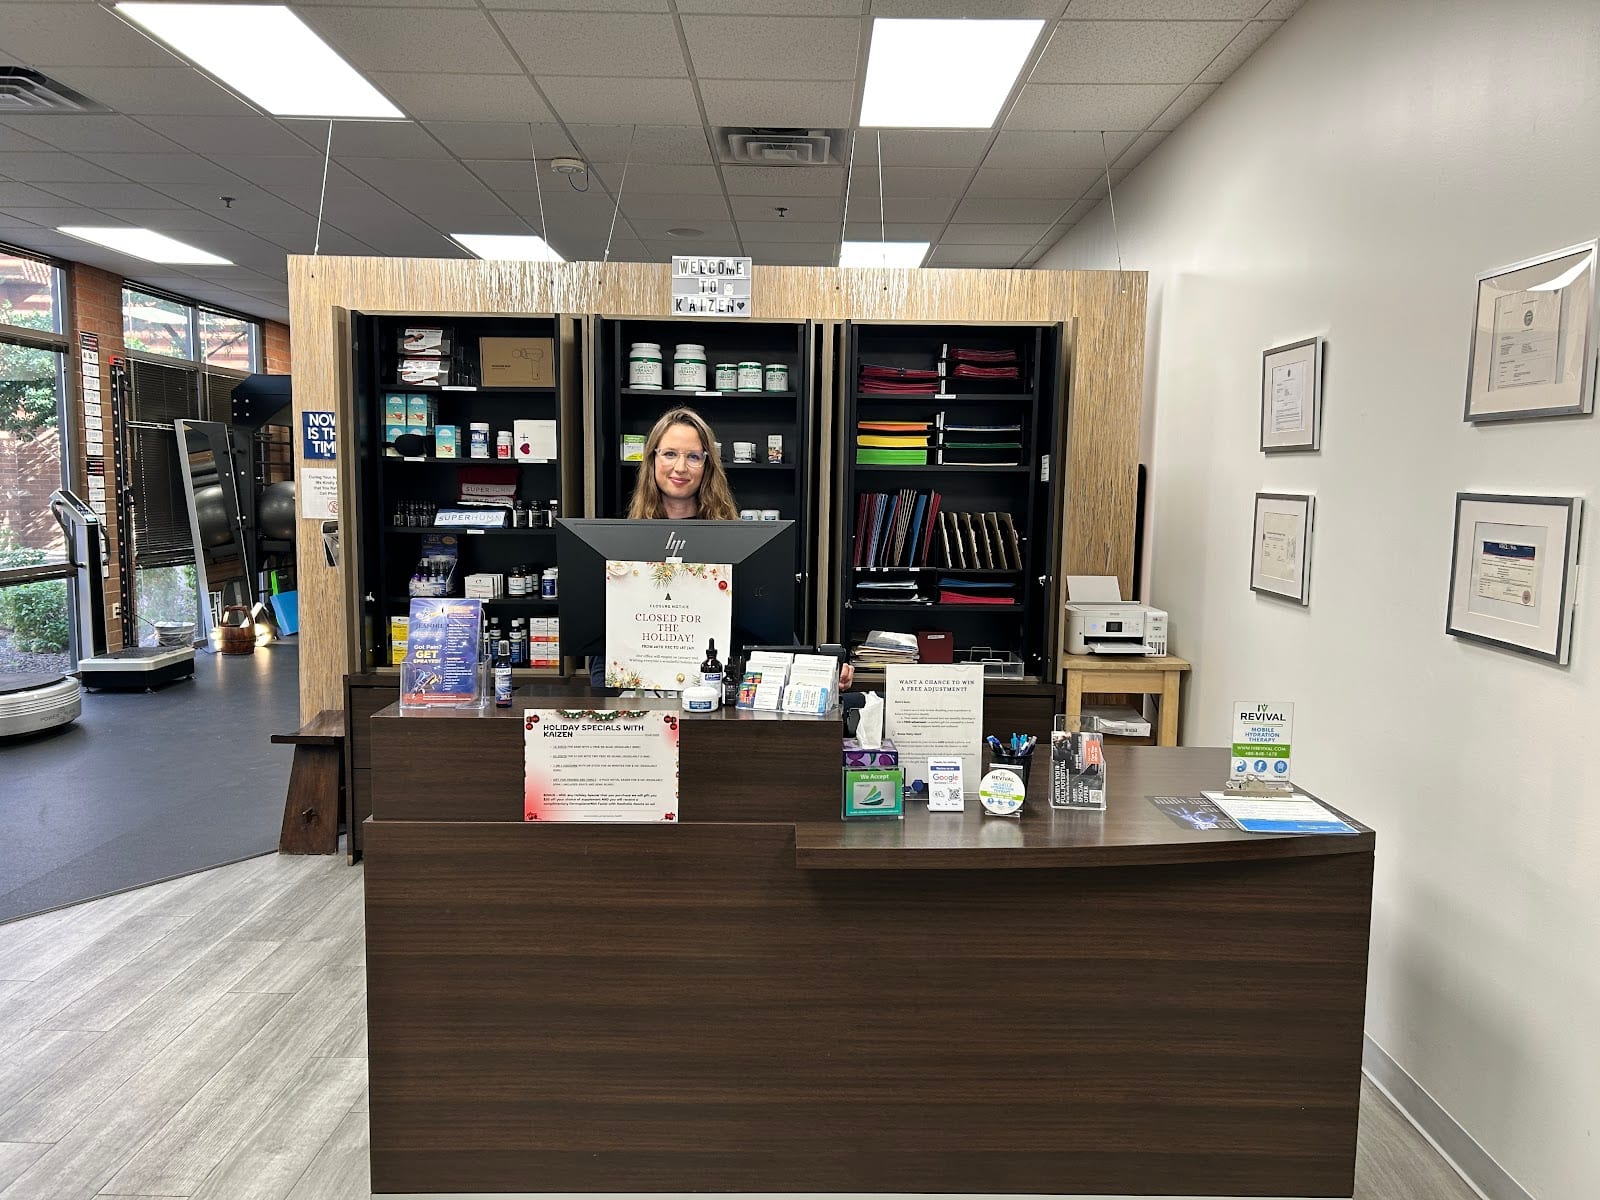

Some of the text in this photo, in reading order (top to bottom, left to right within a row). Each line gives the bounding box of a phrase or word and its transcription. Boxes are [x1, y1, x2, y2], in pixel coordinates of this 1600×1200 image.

[680, 261, 742, 275] WELCOME
[701, 280, 717, 293] TO
[675, 298, 734, 312] KAIZEN
[307, 427, 336, 440] IS TH
[312, 441, 336, 453] TIM
[635, 613, 701, 623] CLOSED FOR
[657, 624, 679, 632] THE
[642, 633, 694, 642] HOLIDAY!
[1258, 704, 1268, 712] IV
[1240, 713, 1286, 722] REVIVAL
[932, 773, 959, 782] Google
